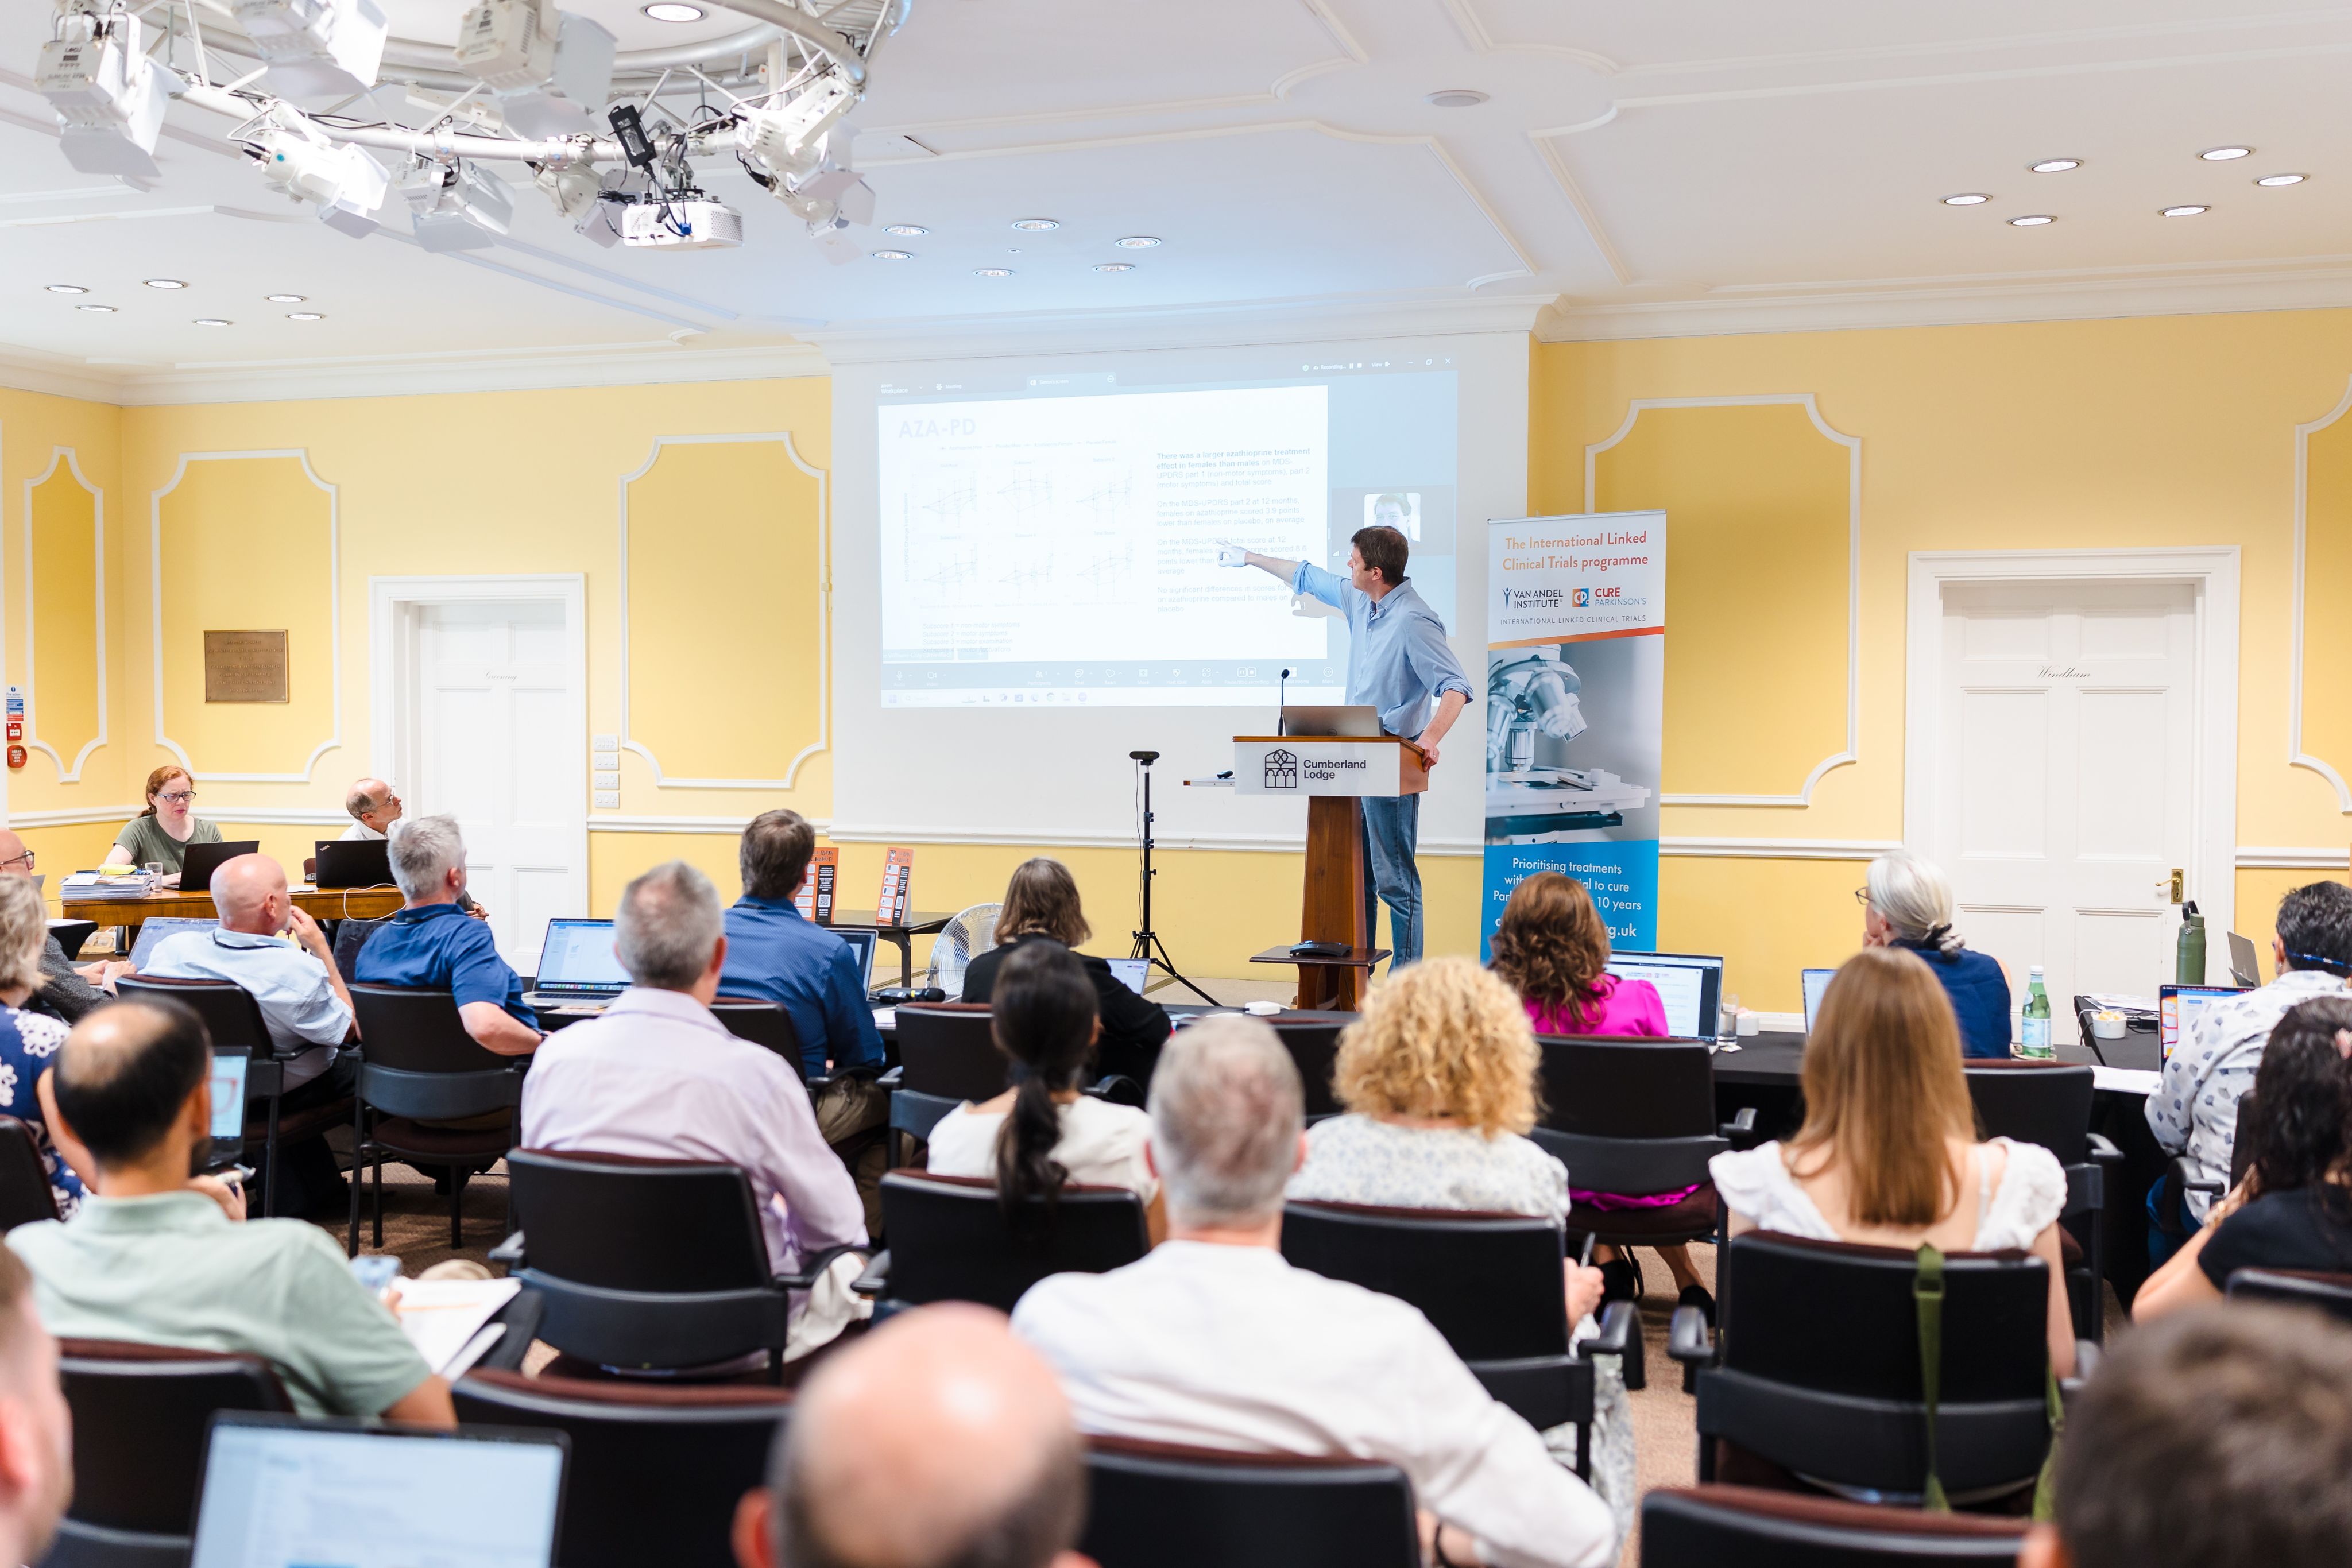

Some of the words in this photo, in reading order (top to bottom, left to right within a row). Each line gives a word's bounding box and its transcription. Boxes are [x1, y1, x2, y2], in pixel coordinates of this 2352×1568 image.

[899, 418, 977, 439] AZA-PD
[1227, 450, 1272, 458] azathioprine
[1157, 471, 1183, 479] UPDRS
[1185, 471, 1199, 479] part
[1208, 470, 1244, 478] (non-motor
[1247, 468, 1287, 477] symptoms),
[1157, 481, 1179, 489] (motor
[1181, 479, 1218, 489] symptoms)
[1231, 498, 1244, 506] part
[1272, 497, 1299, 505] months,
[1279, 506, 1299, 514] points
[1234, 517, 1263, 526] placebo,
[1505, 537, 1526, 550] The
[1530, 533, 1603, 549] International
[1607, 531, 1646, 545] Linked
[1158, 557, 1177, 566] points
[1502, 556, 1544, 571] Clinical
[1548, 555, 1578, 569] Trials
[1581, 556, 1649, 572] programme
[1170, 585, 1202, 594] significant
[1514, 590, 1531, 598] VAN
[1533, 589, 1563, 598] ANDEL
[1595, 587, 1620, 598] CURE
[1169, 595, 1209, 603] azathioprine
[1212, 594, 1245, 603] compared
[1595, 598, 1646, 606] PARKINSON'S
[1158, 605, 1184, 613] placebo
[1500, 617, 1555, 625] INTERNATIONAL
[2037, 665, 2091, 679] Windham
[1303, 759, 1367, 769] Cumberland
[1303, 769, 1336, 780] Lodge
[1512, 858, 1566, 874] Prioritising
[1569, 862, 1622, 874] treatments
[1595, 881, 1604, 891] to
[1608, 881, 1630, 893] cure
[1597, 897, 1610, 909] 10
[1613, 899, 1641, 912] years
